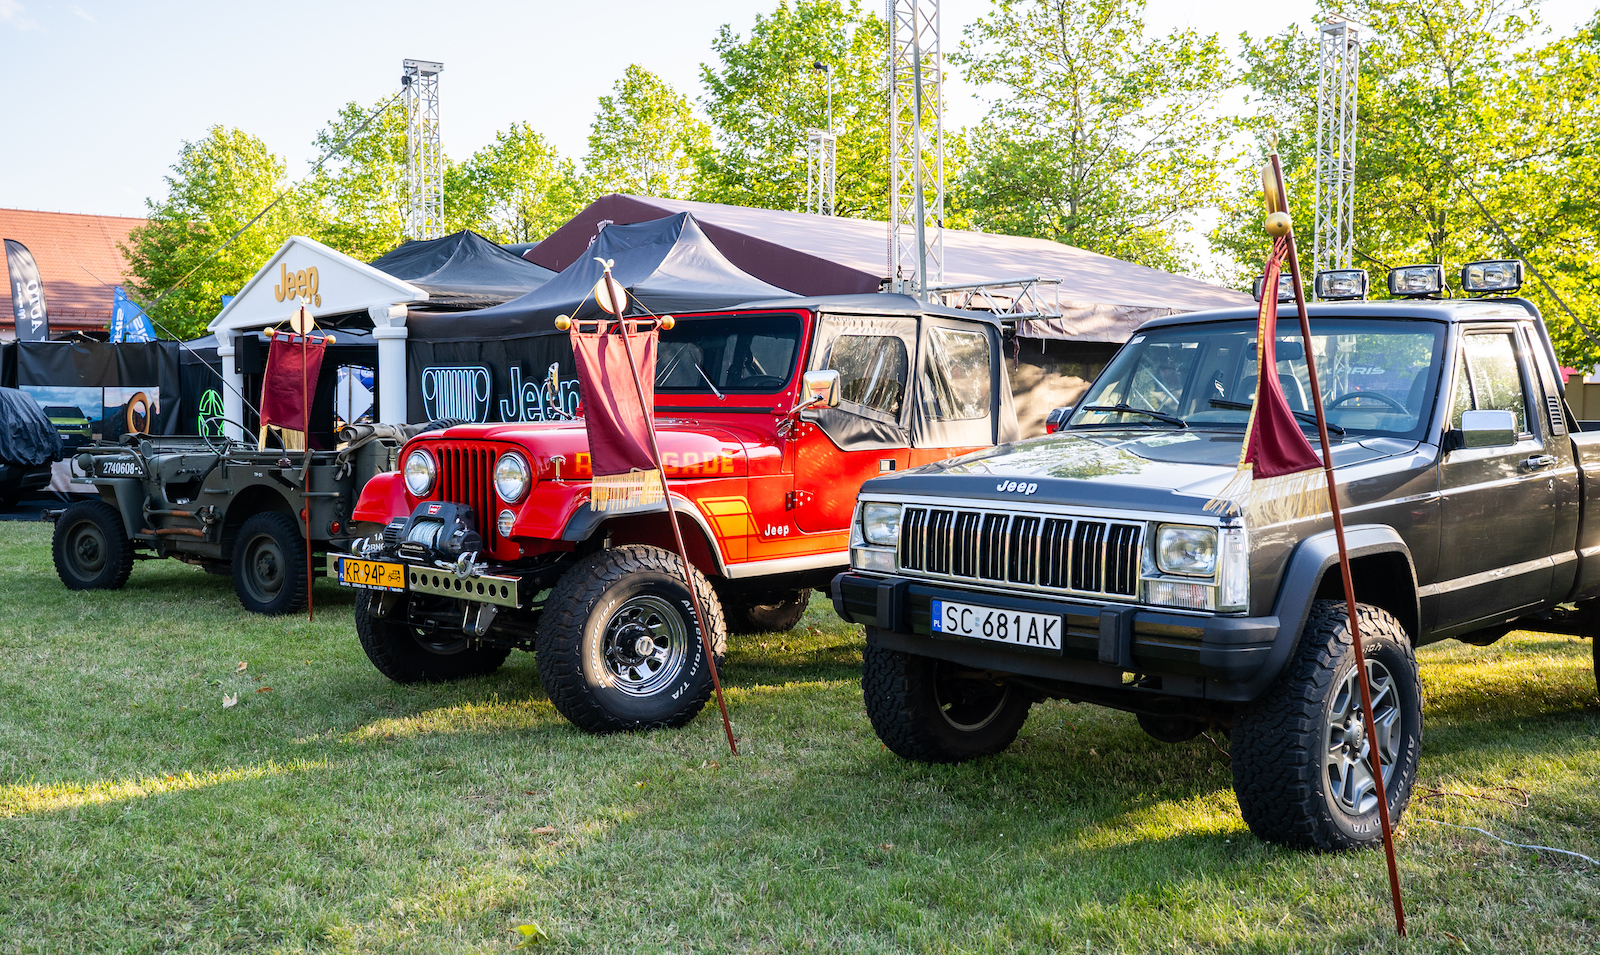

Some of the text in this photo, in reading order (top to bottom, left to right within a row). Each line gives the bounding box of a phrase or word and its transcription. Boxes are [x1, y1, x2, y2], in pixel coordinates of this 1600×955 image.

[274, 263, 319, 304] Jeep
[574, 451, 734, 474] RGADE
[997, 480, 1037, 495] Jeep
[764, 524, 789, 536] Jeep
[345, 561, 385, 584] KR 94P
[933, 619, 941, 628] PL
[946, 606, 1058, 647] SC 681AK
[671, 681, 691, 700] T/A
[1374, 735, 1415, 827] All-Terrn
